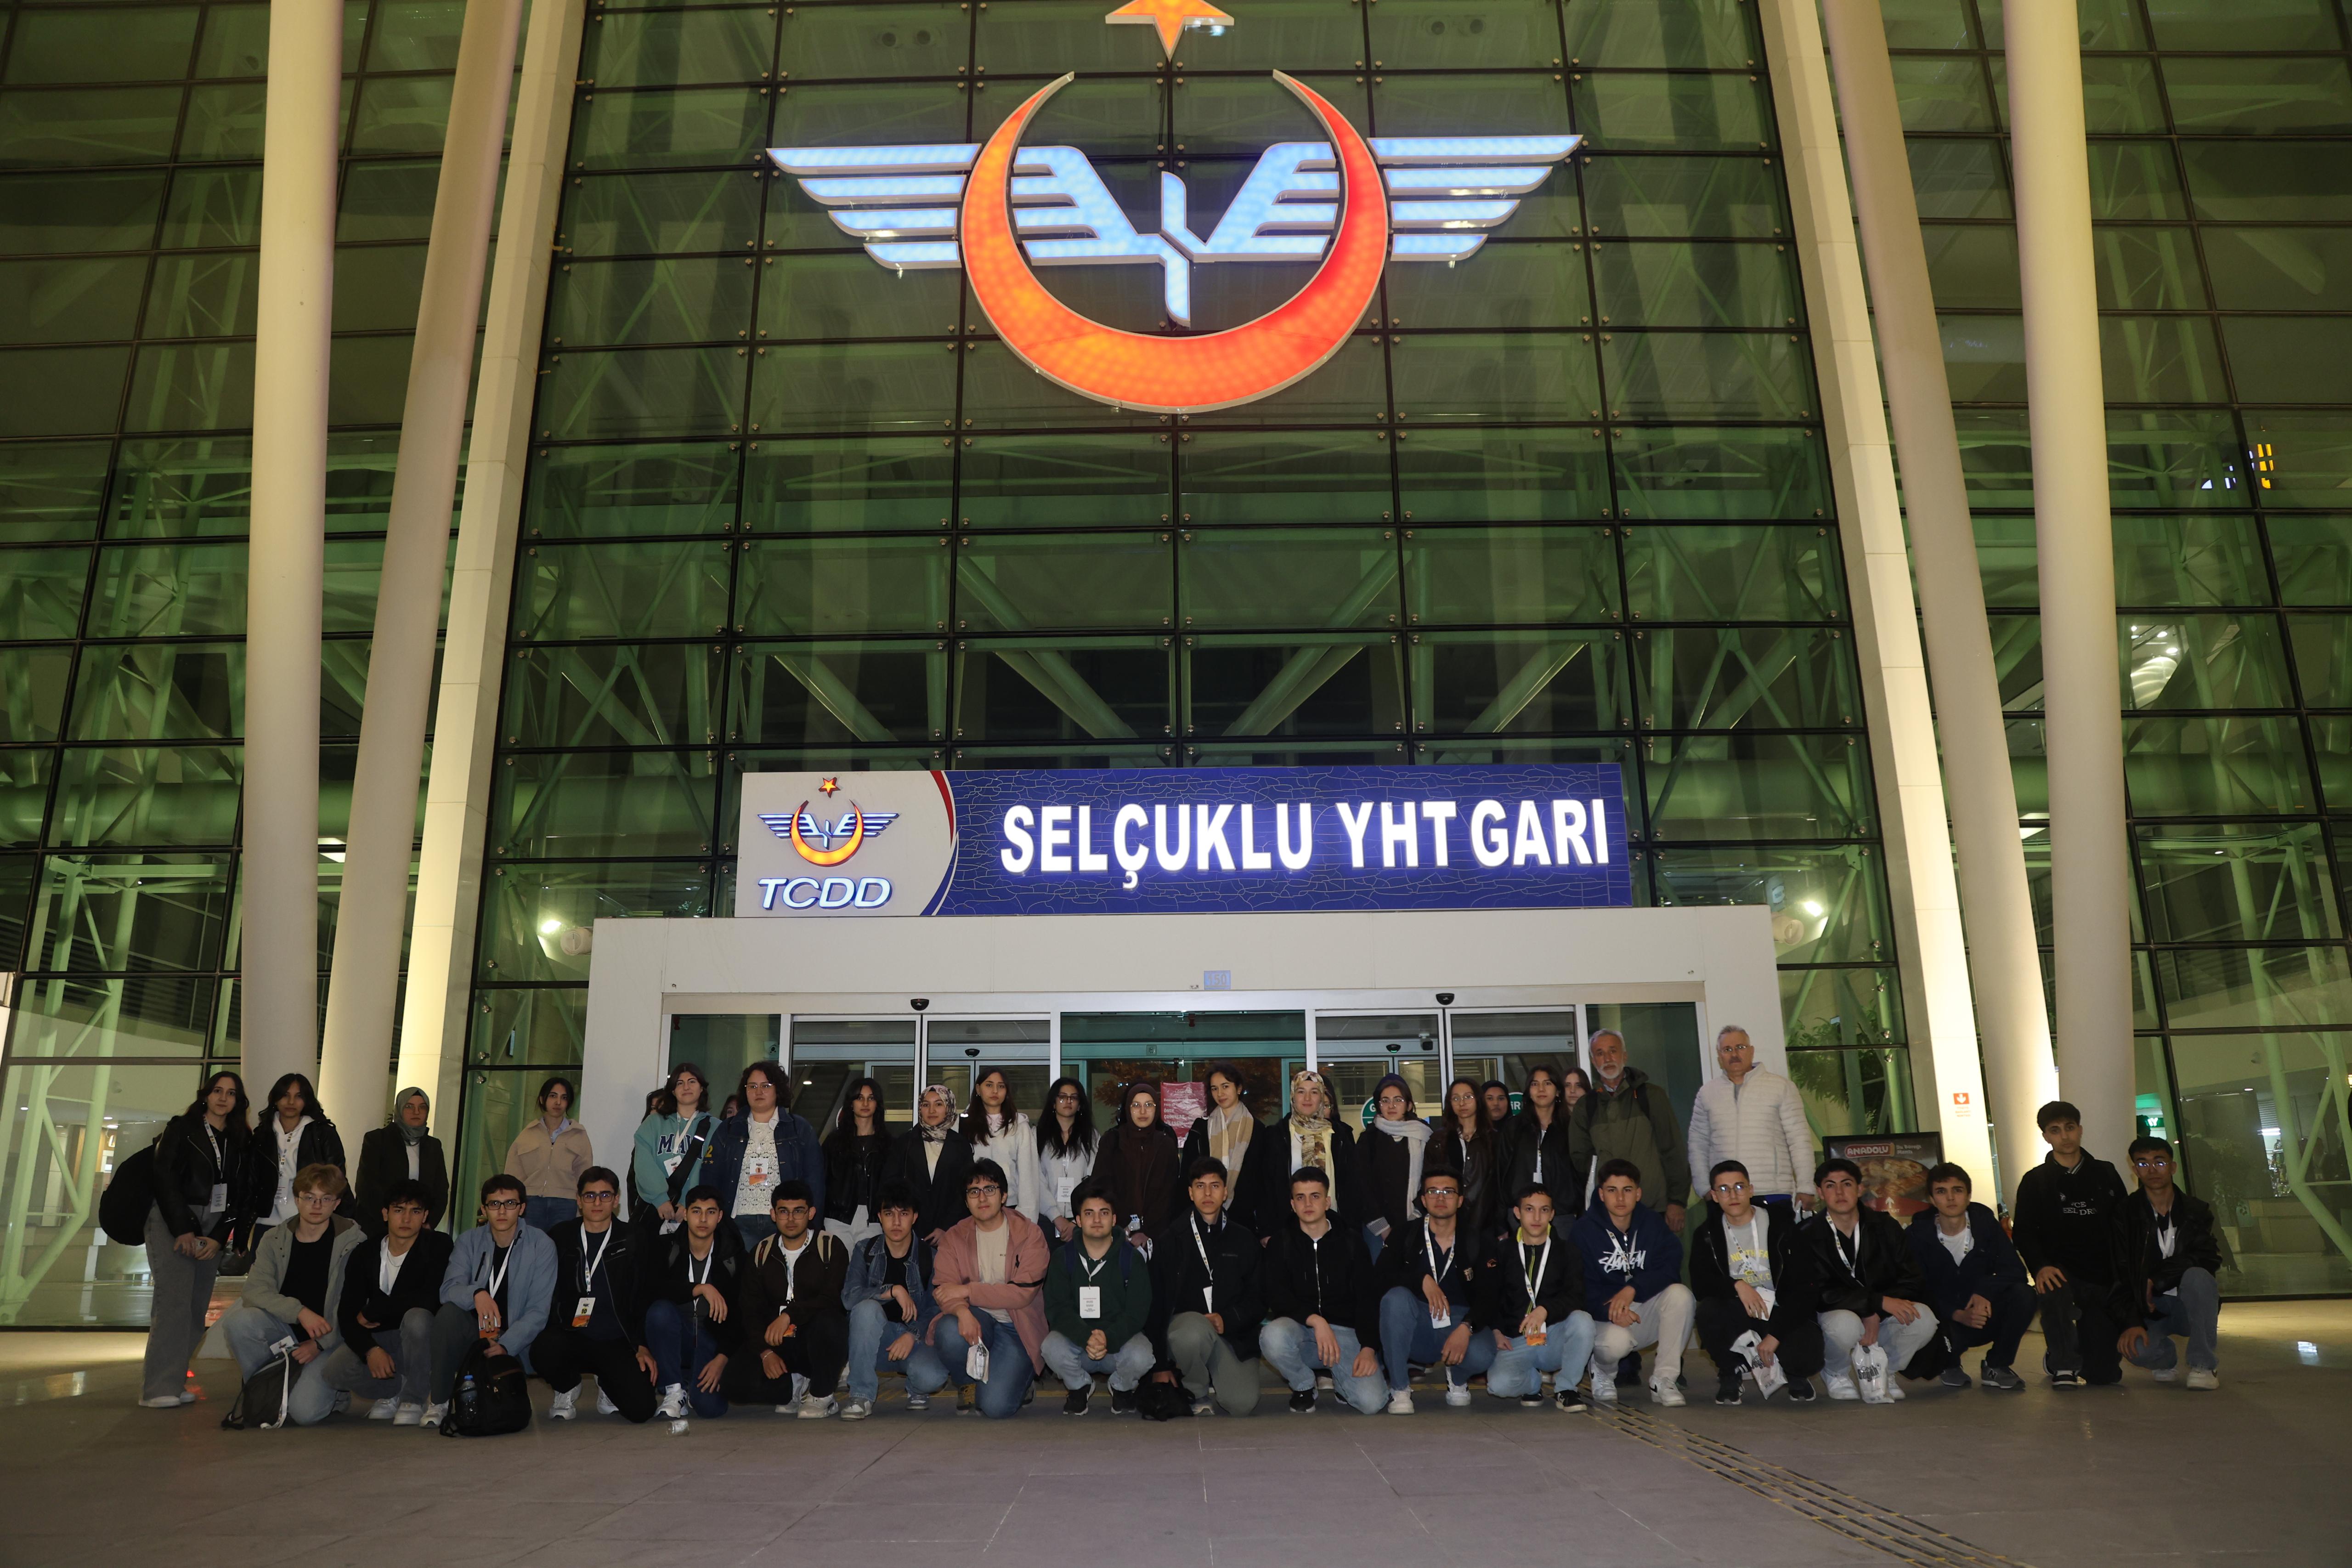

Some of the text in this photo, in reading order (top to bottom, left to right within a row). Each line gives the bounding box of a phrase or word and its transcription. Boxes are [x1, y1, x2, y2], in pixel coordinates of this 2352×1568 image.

[1001, 798, 1610, 890] SELÇUKLU YHT GARI
[758, 877, 893, 910] TCDD
[1846, 1146, 1889, 1155] ANADOLU
